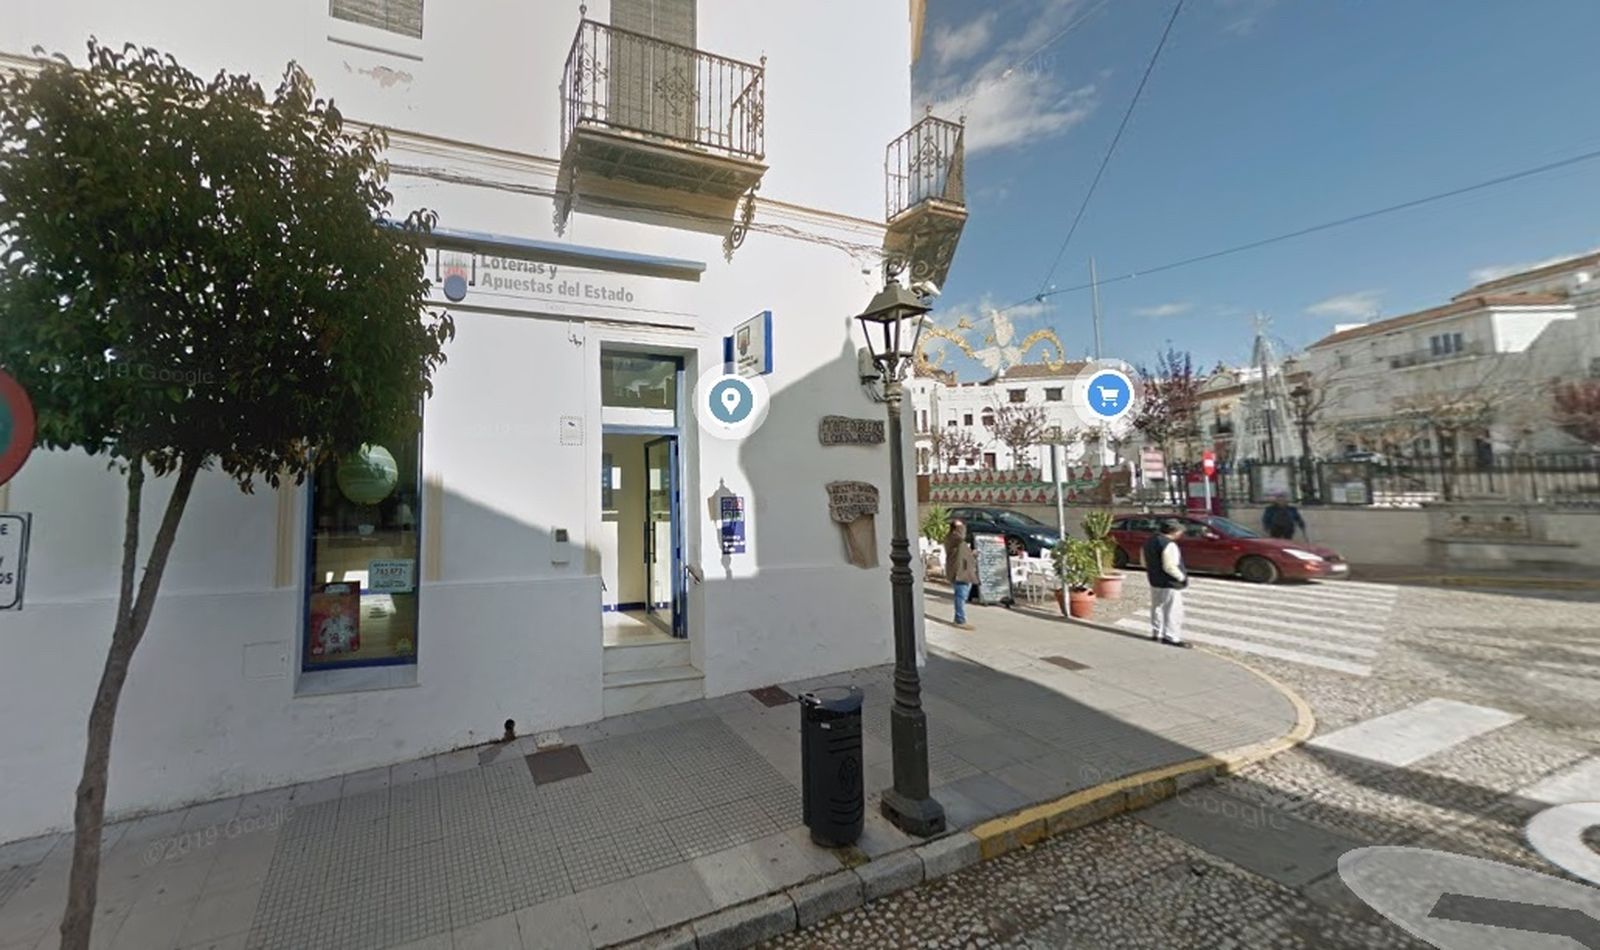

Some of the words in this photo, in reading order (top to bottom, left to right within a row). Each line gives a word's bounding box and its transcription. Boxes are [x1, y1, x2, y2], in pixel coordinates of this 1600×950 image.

[548, 264, 558, 280] y
[481, 272, 553, 295] Apuestas
[558, 279, 580, 297] del
[584, 284, 634, 303] Estado
